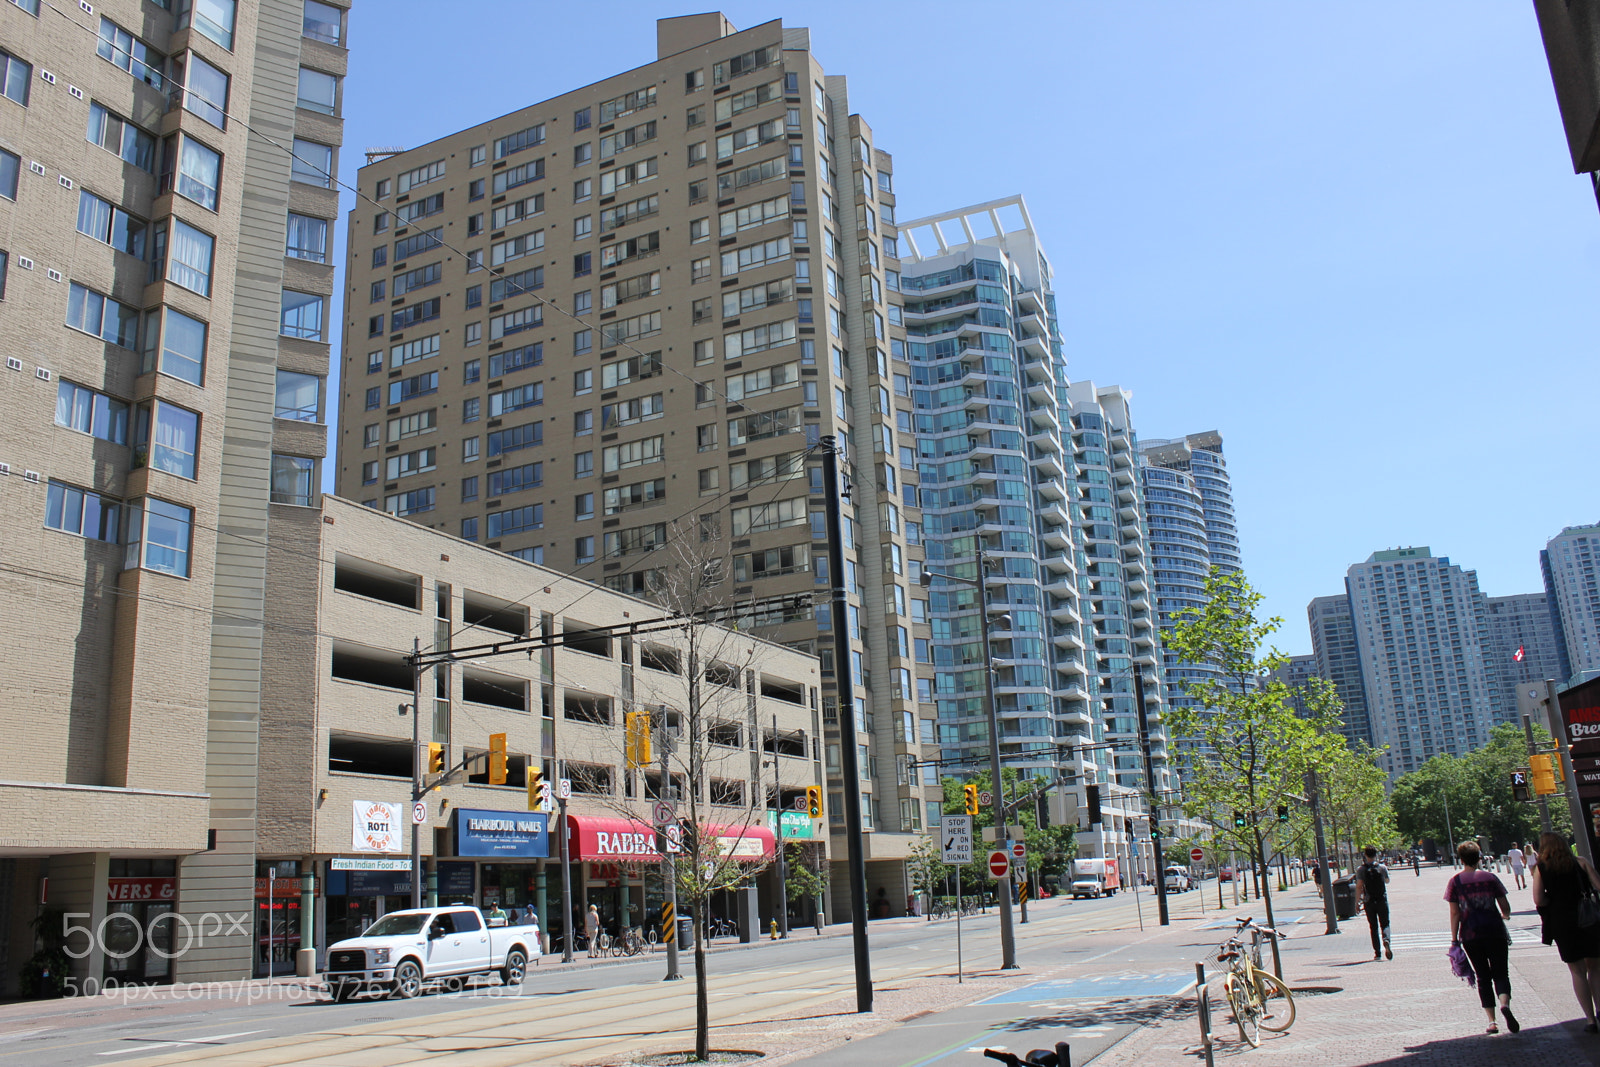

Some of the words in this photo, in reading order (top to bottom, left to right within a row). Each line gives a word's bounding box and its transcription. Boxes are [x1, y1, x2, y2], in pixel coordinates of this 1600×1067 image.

[367, 822, 389, 832] ROTI
[468, 818, 516, 831] HARBOUR
[516, 820, 541, 832] NAILS
[596, 831, 658, 855] RABBA
[333, 859, 353, 869] Fresh
[355, 860, 375, 869] Indian
[377, 861, 394, 869] Food
[400, 861, 407, 869] To
[160, 883, 175, 898] &
